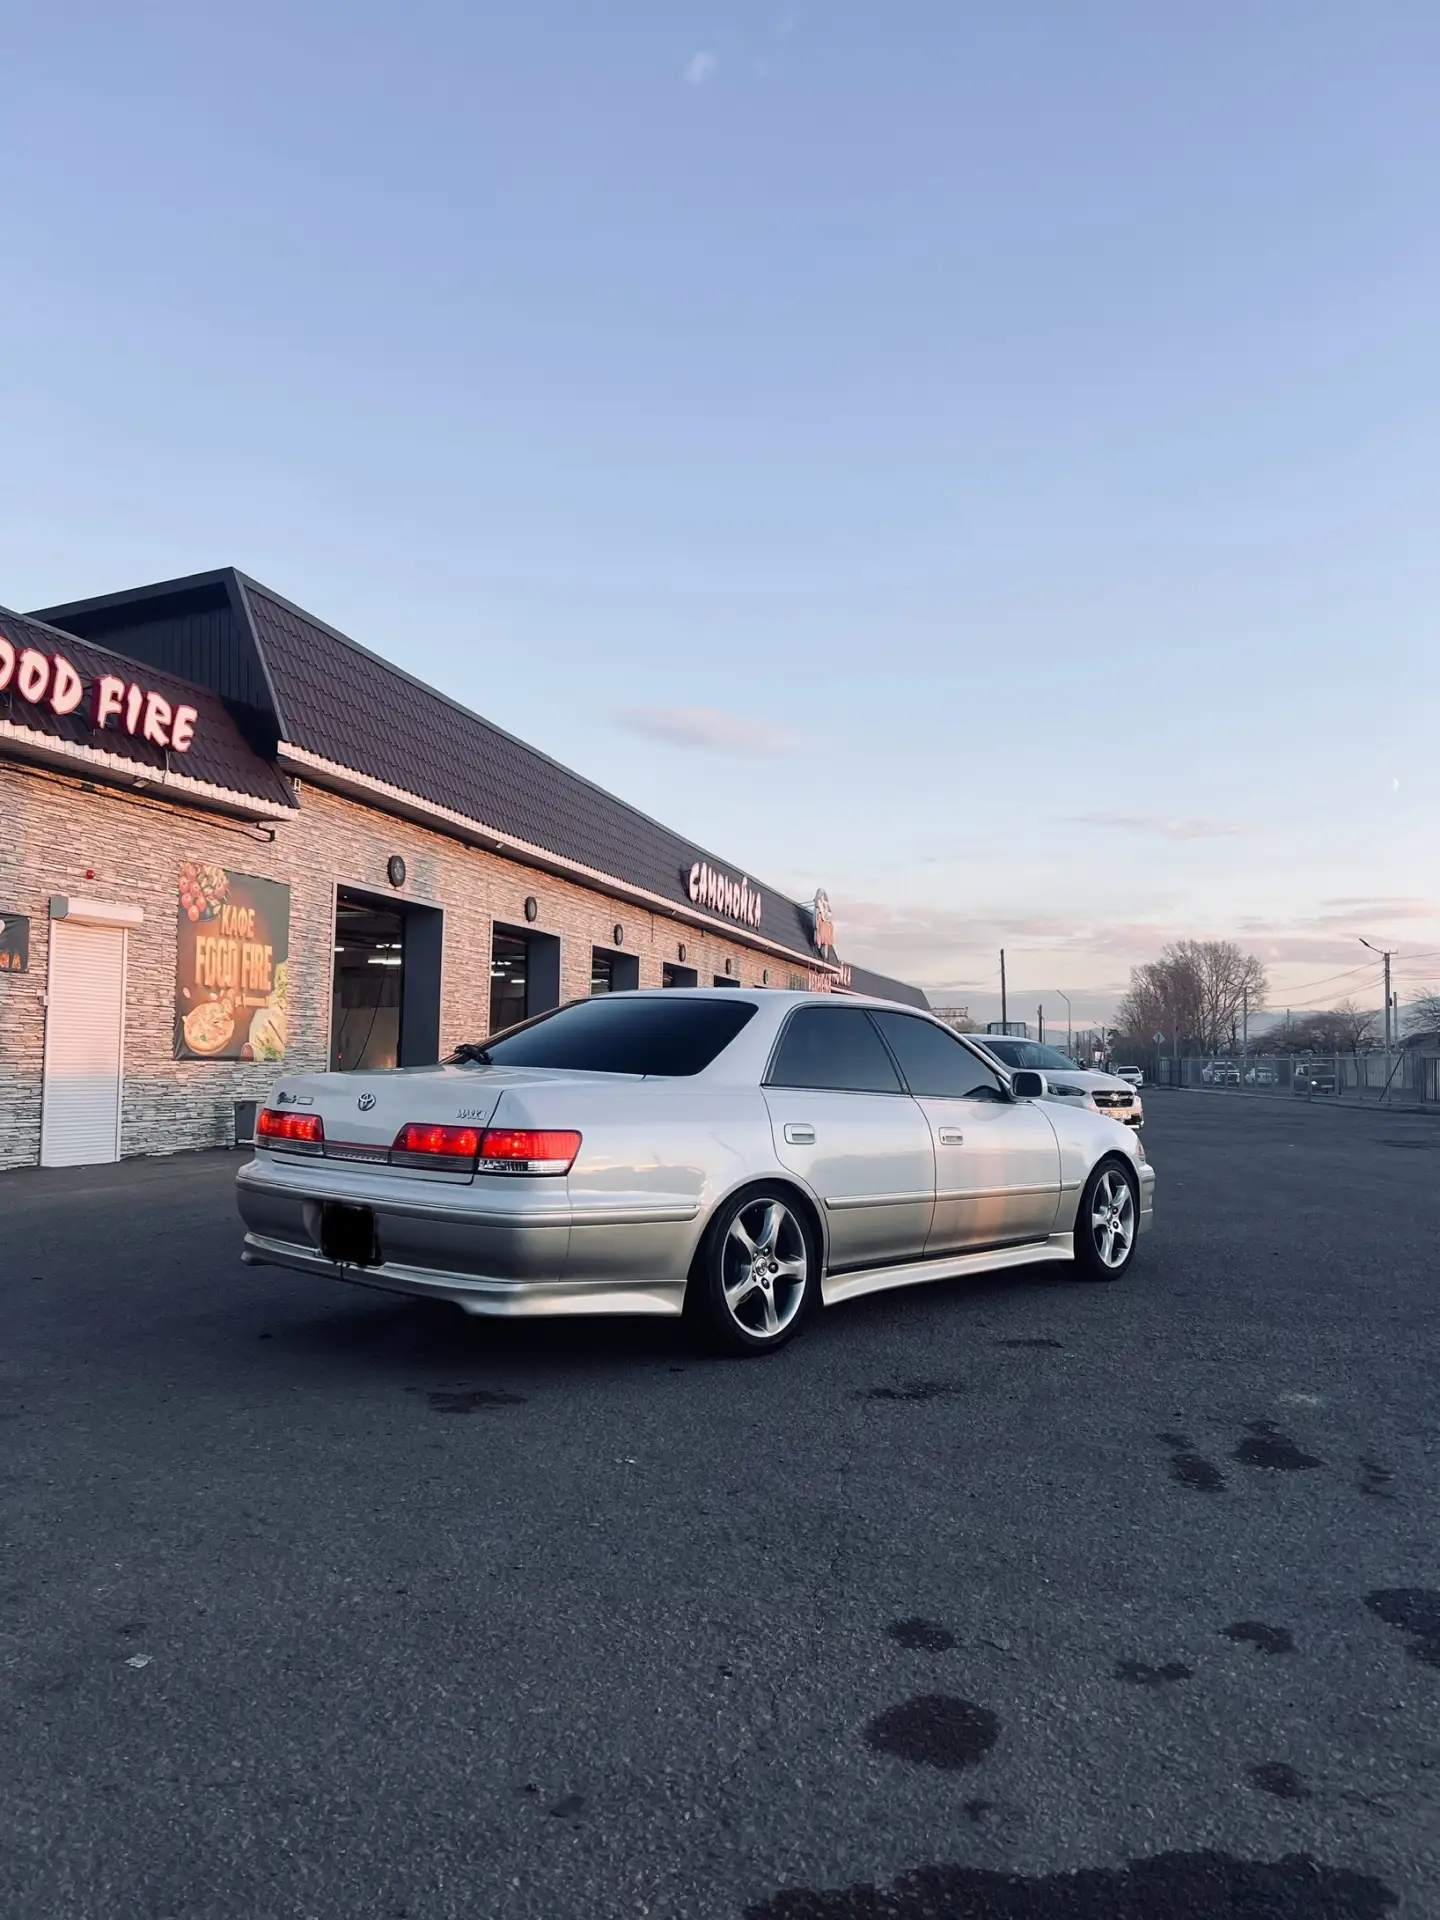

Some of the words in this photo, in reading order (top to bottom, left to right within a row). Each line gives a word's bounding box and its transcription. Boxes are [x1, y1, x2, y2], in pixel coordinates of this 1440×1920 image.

[97, 674, 198, 752] FIRE
[220, 903, 256, 939] КАФЕ
[689, 862, 762, 928] САМОМОЙКА
[195, 935, 238, 988] FOOD
[241, 942, 273, 991] FIRE
